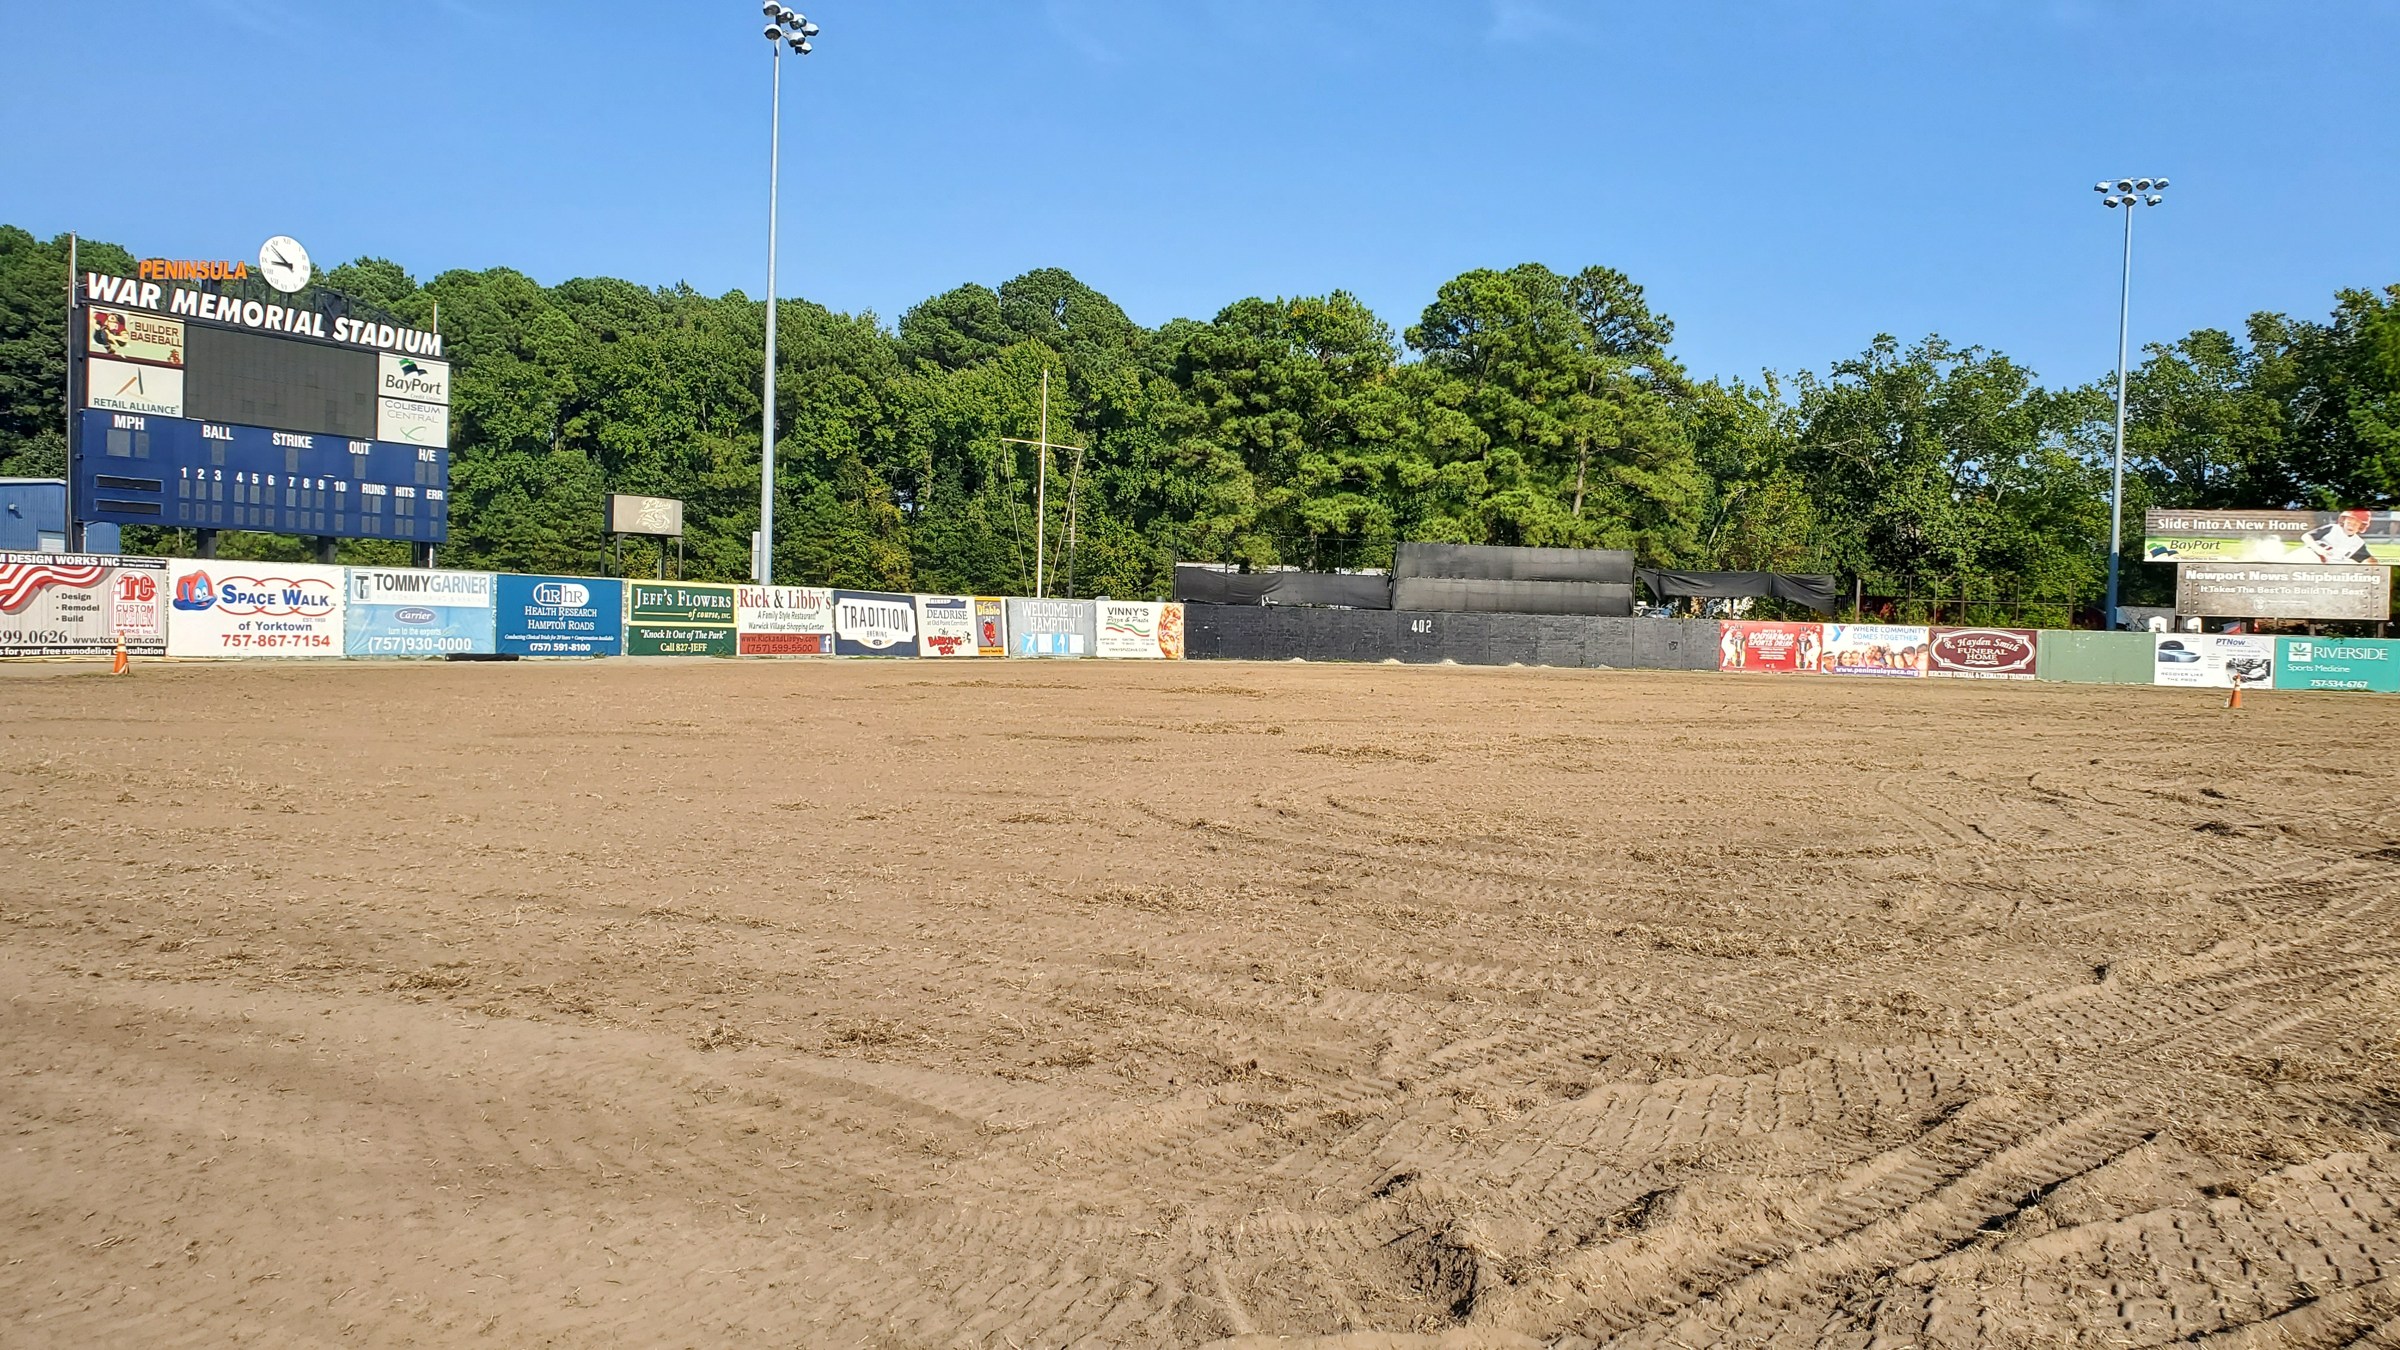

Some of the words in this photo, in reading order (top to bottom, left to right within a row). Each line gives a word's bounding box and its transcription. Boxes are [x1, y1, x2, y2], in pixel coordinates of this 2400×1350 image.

[139, 259, 248, 280] PENINSULA
[87, 271, 161, 310] WAR
[170, 287, 325, 338] MEMORIAL
[332, 316, 442, 357] STADIUM
[135, 321, 179, 337] BUILDER
[130, 331, 182, 347] BASEBALL
[385, 374, 442, 395] BayPort
[93, 397, 127, 409] RETAIL
[385, 400, 441, 414] COLISEUM
[113, 414, 145, 430] MPH
[387, 410, 439, 423] CENTRAL
[202, 424, 234, 440] BALL
[272, 432, 313, 449] STRIKE
[349, 441, 372, 455] OUT
[418, 448, 437, 462] H/E
[180, 466, 187, 478] 1
[197, 468, 205, 480] 2
[214, 469, 222, 481] 3
[236, 471, 243, 483] 4
[251, 473, 259, 485] 5
[267, 474, 275, 486] 6
[288, 476, 295, 487] 7
[302, 477, 310, 489] 8
[317, 479, 325, 490] 9
[333, 481, 347, 492] 10
[361, 483, 387, 496] RUNS
[395, 486, 415, 498] HITS
[426, 489, 443, 500] ERR
[2158, 518, 2189, 529] Slide
[2193, 519, 2219, 530] Into
[2222, 520, 2232, 530] A
[2236, 519, 2264, 530] New
[2268, 520, 2308, 530] Home
[2170, 540, 2221, 551] BayPort
[8, 553, 53, 564] DESIGN
[55, 555, 98, 566] WORKS
[100, 557, 120, 567] INC
[2185, 569, 2246, 582] Newport
[2248, 570, 2289, 580] News
[2291, 571, 2381, 584] Shipbuilding
[222, 584, 276, 605] SPACE
[282, 589, 329, 607] WALK
[2200, 585, 2208, 593] It
[2209, 585, 2235, 593] Takes
[2257, 586, 2279, 594] Best
[2279, 586, 2291, 594] To
[2293, 587, 2320, 595] Build
[2320, 587, 2339, 595] The
[61, 593, 92, 601] Design
[634, 588, 673, 609] JEFF'S
[677, 590, 731, 608] FLOWERS
[739, 587, 770, 608] Rick
[774, 589, 784, 609] &
[788, 589, 831, 614] Libby's
[116, 604, 154, 613] CUSTOM
[399, 610, 432, 620] Carrier
[524, 606, 557, 616] HEALTH
[558, 606, 597, 618] RESEARCH
[687, 608, 697, 621] of
[926, 609, 968, 620] DEADRISE
[976, 603, 1001, 616] Diablo
[1021, 601, 1068, 617] WELCOME
[1071, 603, 1083, 618] TO
[1107, 606, 1149, 616] VINNY'S
[762, 611, 778, 621] Family
[779, 611, 790, 621] Style
[791, 612, 816, 620] Restaurant
[842, 605, 908, 632] TRADITION
[238, 621, 251, 631] of
[255, 621, 312, 631] Yorktown
[528, 619, 566, 630] HAMPTON
[568, 620, 594, 631] ROADS
[748, 622, 769, 630] Warwick
[770, 622, 785, 632] Village
[786, 623, 808, 632] Shopping
[808, 623, 825, 631] Center
[1030, 617, 1075, 633] HAMPTON
[1411, 619, 1432, 633] 402
[1880, 626, 1926, 634] COMMUNITY
[72, 636, 163, 645] www.tccutom.com
[221, 635, 330, 647] 757-867-7154
[665, 630, 672, 639] It
[672, 630, 686, 639] Out
[686, 630, 695, 641] of
[695, 630, 708, 639] The
[1880, 633, 1918, 641] TOGETHER
[2215, 638, 2246, 646] PTNow
[368, 636, 472, 654] (757)930-0000
[530, 642, 551, 652] (757)
[553, 643, 591, 652] 591-8100
[660, 643, 675, 652] Call
[675, 643, 708, 653] 827-JEFF
[747, 644, 770, 654] (757)
[1957, 637, 1991, 647] Hayden
[1993, 638, 2020, 652] Smith
[5, 647, 19, 655] for
[20, 648, 40, 657] your
[42, 647, 61, 655] free
[62, 646, 111, 657] remodeling
[2313, 646, 2388, 661] RIVERSIDE
[2288, 664, 2313, 673] Sports
[2315, 664, 2350, 673] Medicine
